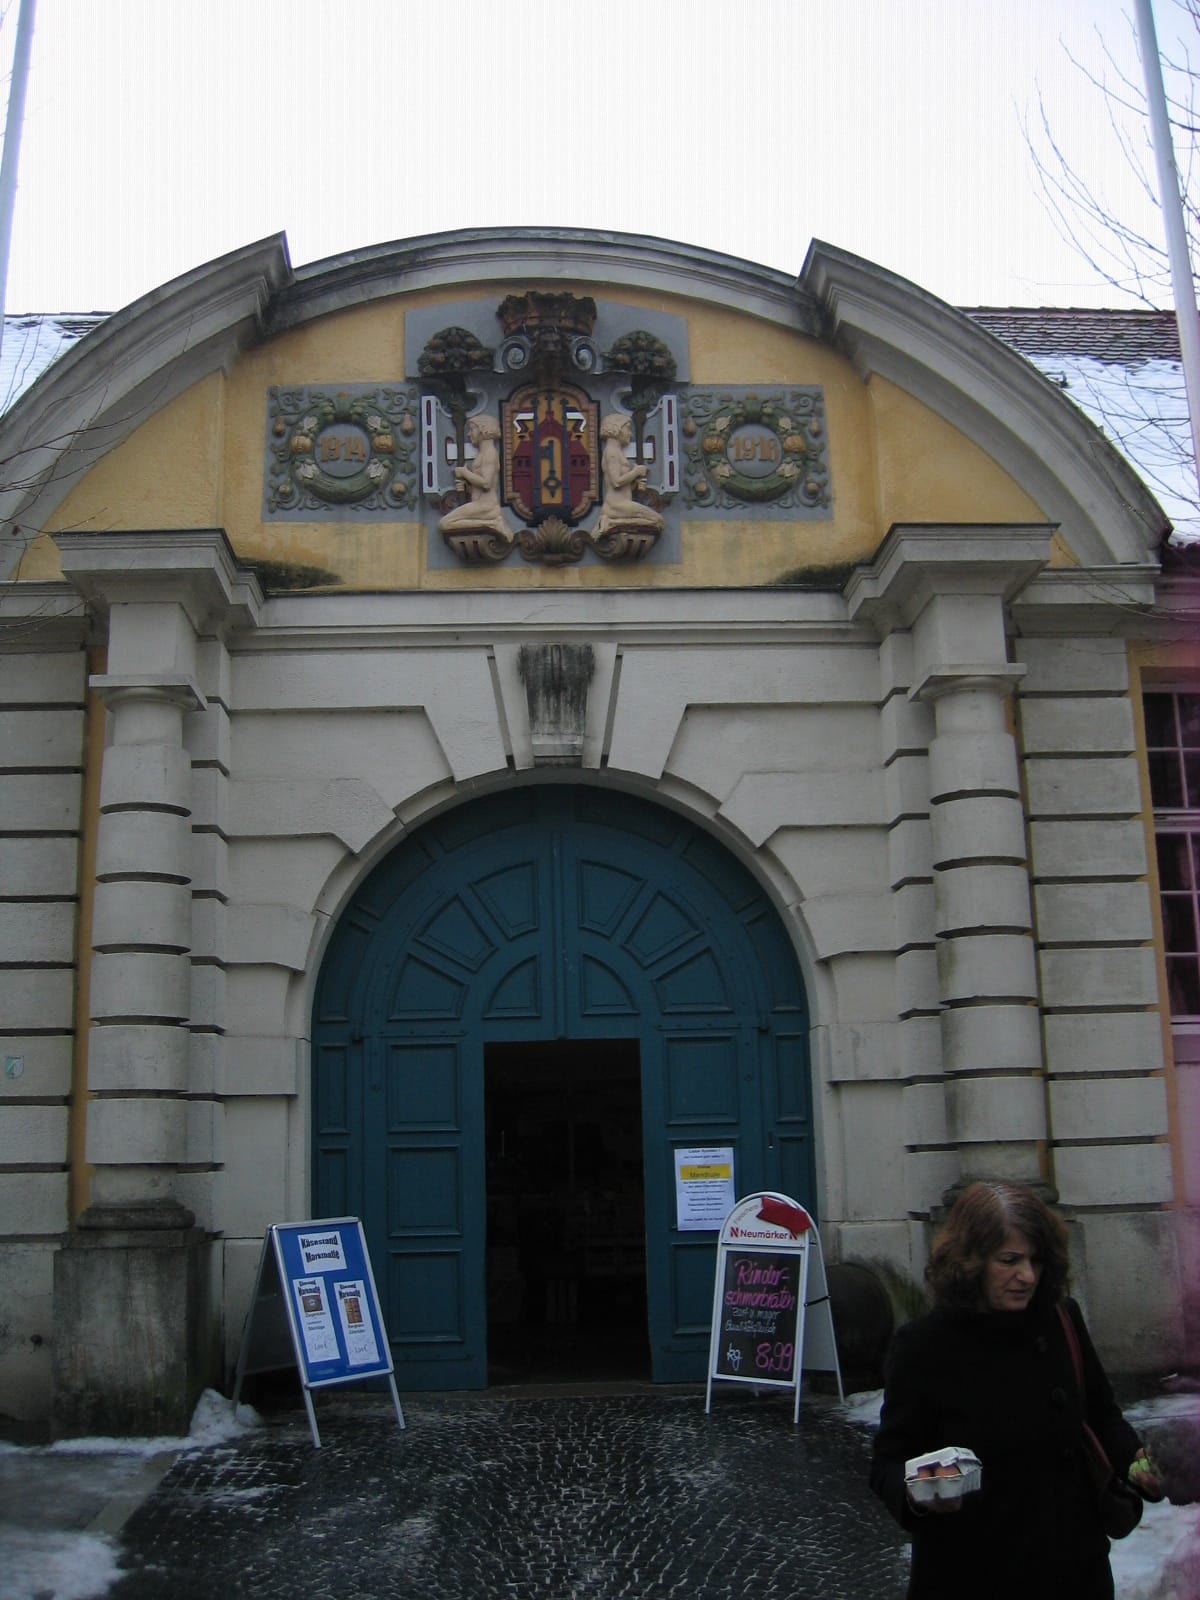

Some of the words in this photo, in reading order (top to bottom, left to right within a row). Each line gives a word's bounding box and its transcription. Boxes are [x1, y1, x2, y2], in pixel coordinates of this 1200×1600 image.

[317, 435, 365, 462] 1914
[300, 1235, 338, 1249] Käsestand
[740, 1229, 788, 1240] Neumärker
[734, 1259, 791, 1286] Rinder-
[726, 1342, 743, 1371] kg
[755, 1342, 794, 1372] 8,99
